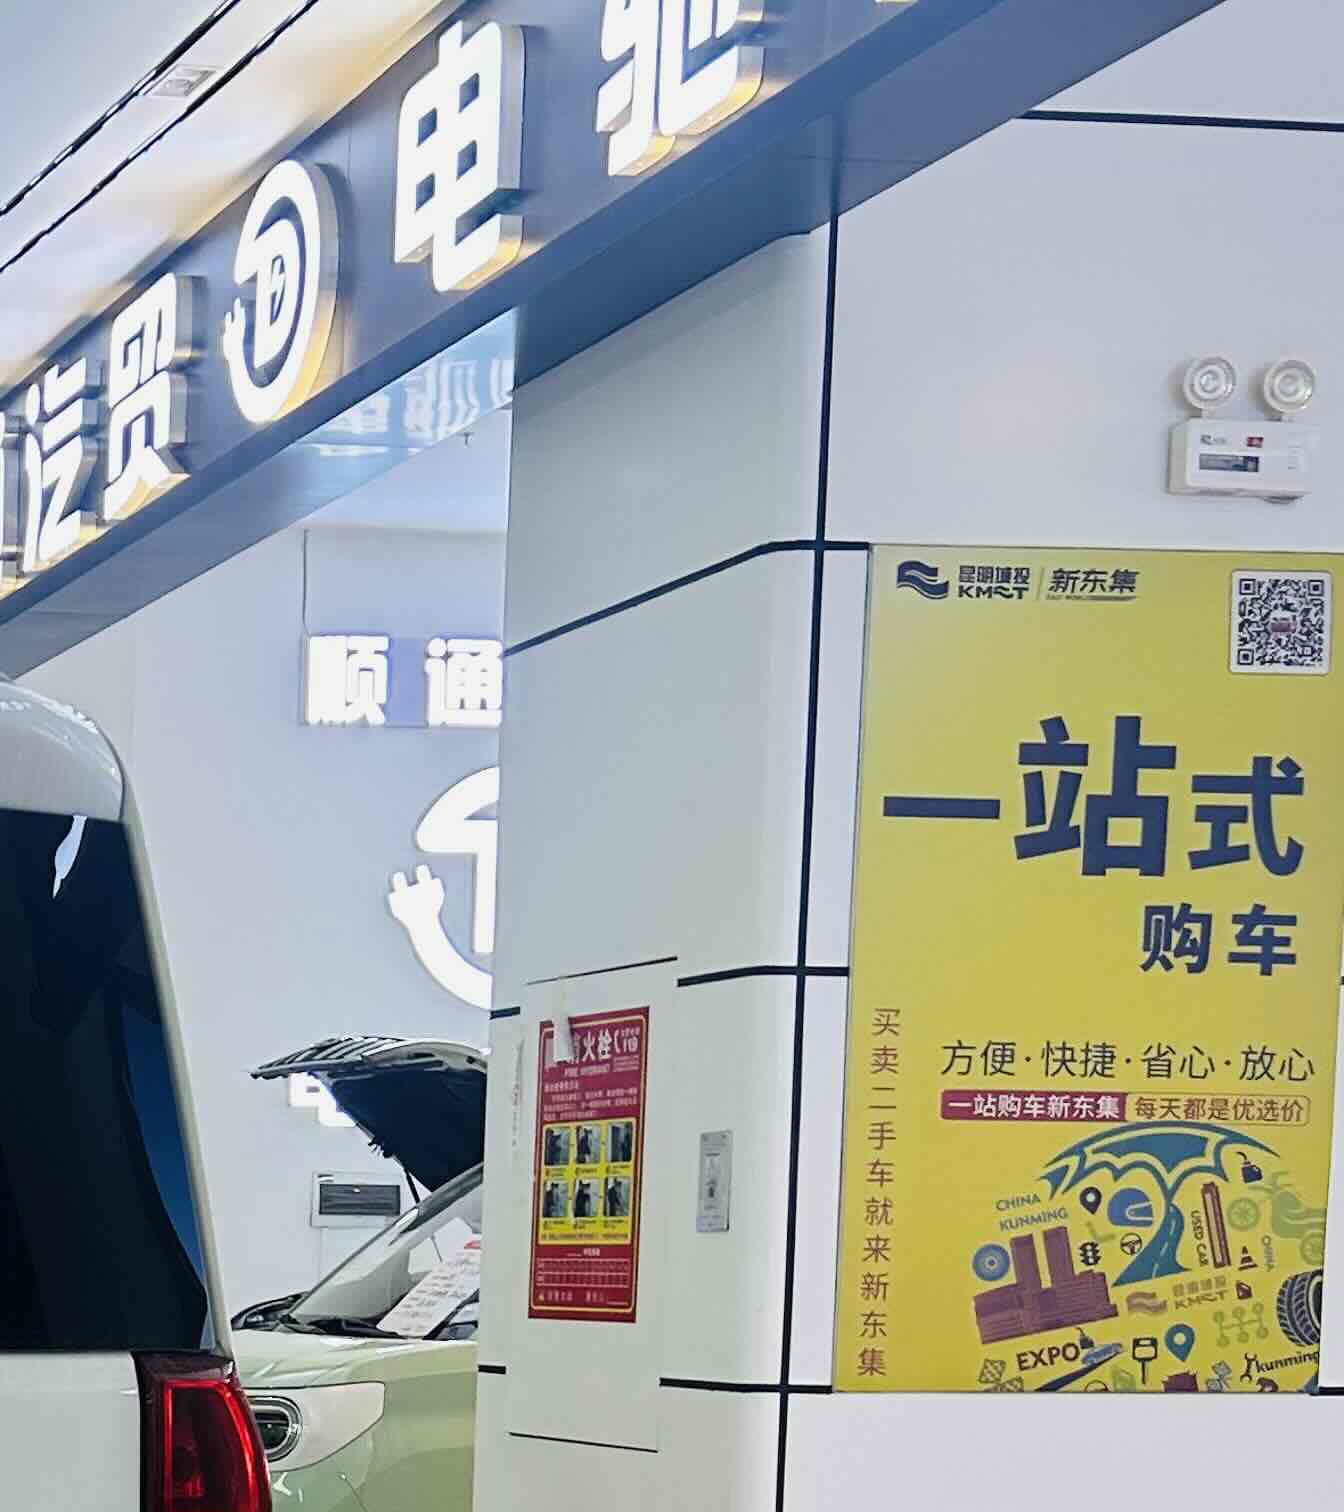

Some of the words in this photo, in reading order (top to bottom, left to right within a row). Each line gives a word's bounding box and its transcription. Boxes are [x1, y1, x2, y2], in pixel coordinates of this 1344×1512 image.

[1048, 567, 1141, 595] 新东集
[305, 635, 502, 728] 顺通
[883, 716, 1305, 877] 一站式
[1140, 902, 1297, 977] 购车
[948, 1093, 1120, 1120] 一站购车新东集
[1134, 1096, 1304, 1123] 每天都是优选价
[856, 1007, 902, 1377] 买卖二手车就来新东集
[995, 1193, 1041, 1212] CHINA
[998, 1207, 1068, 1233] KUNMING
[1016, 1341, 1081, 1372] EXPO
